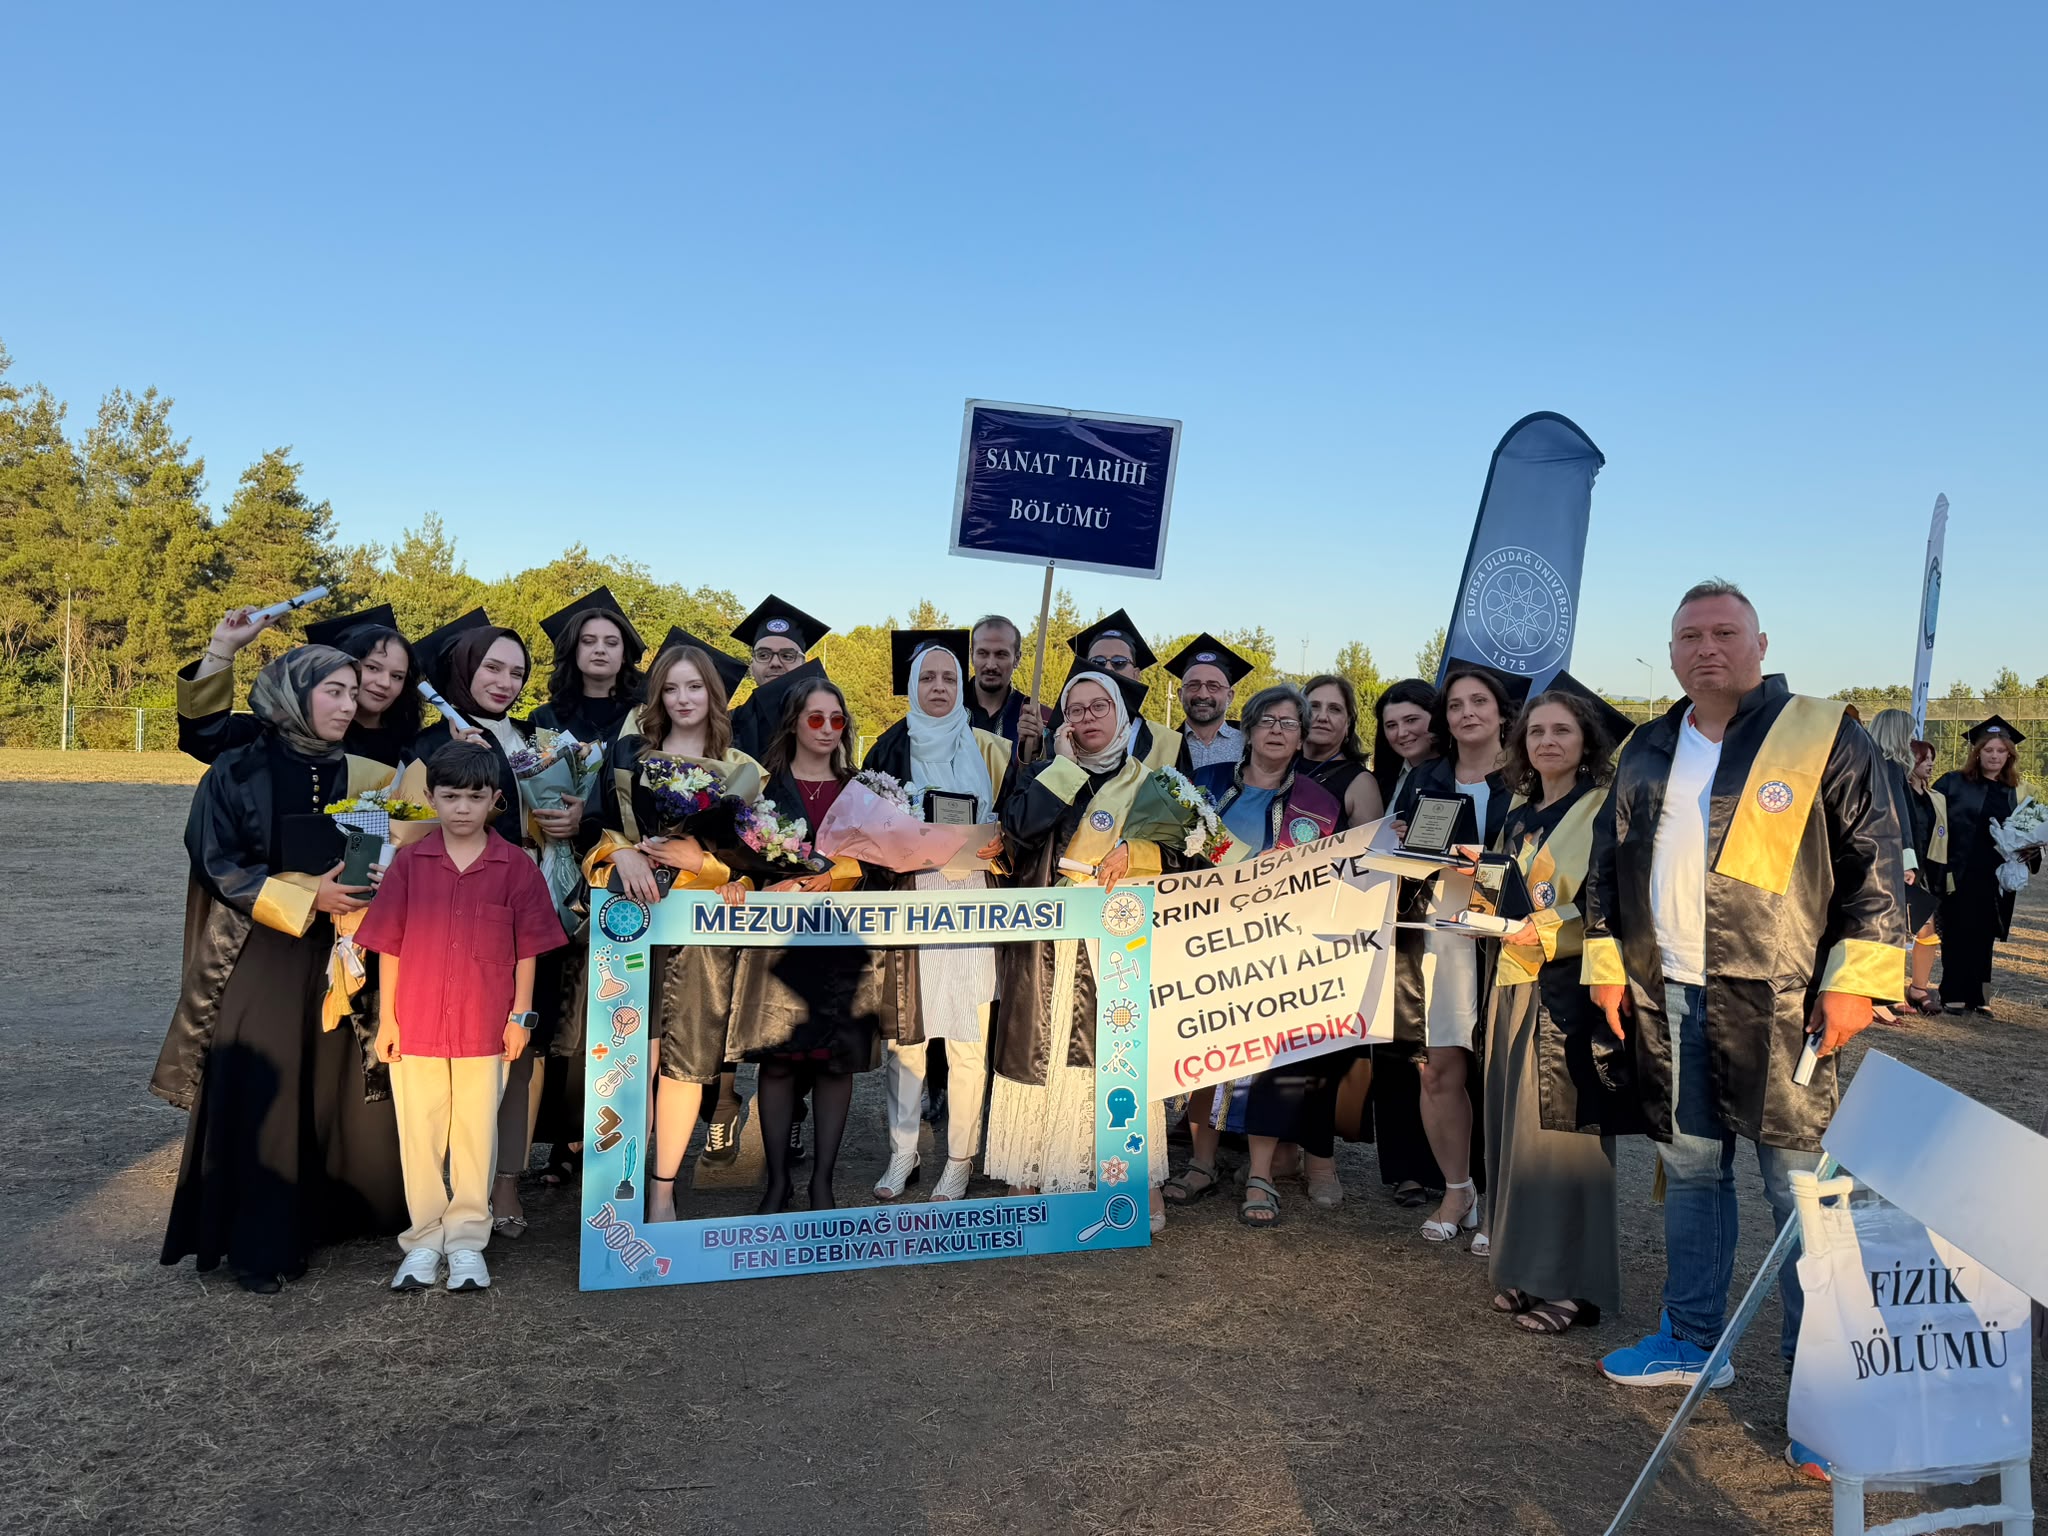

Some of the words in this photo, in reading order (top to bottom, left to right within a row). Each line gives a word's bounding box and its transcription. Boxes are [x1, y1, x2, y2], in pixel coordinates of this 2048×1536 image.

[986, 448, 1059, 476] SANAT
[1067, 455, 1148, 486] TARİHİ
[1009, 498, 1111, 529] BÖLÜMÜ
[1467, 571, 1485, 617] BURSA
[1484, 551, 1532, 571] ULUDAĞ
[1534, 559, 1570, 649] ÜNİVERSİTESİ
[1493, 651, 1526, 671] 1975
[1132, 872, 1224, 895] ONA
[1229, 853, 1370, 913] ÇÖZMEYE
[693, 898, 899, 934] MEZUNİYET
[906, 901, 1064, 933] HATIRASI
[1184, 912, 1303, 959] GELDİK,
[1296, 929, 1384, 972] ALDIK
[1176, 976, 1346, 1040] GİDİYORUZ!
[1173, 1011, 1368, 1087] (ÇÖZEMEDİK)
[703, 1225, 788, 1249] BURSA
[793, 1212, 892, 1241] ULUDAĞ
[897, 1201, 1047, 1233] ÜNİVERSİTESİ
[733, 1249, 778, 1270] FEN
[785, 1239, 898, 1265] EDEBİYAT
[904, 1226, 1023, 1256] FAKÜLTESİ
[1868, 1257, 1972, 1309] FİZİK
[1850, 1320, 2009, 1380] BÖLÜMÜ
